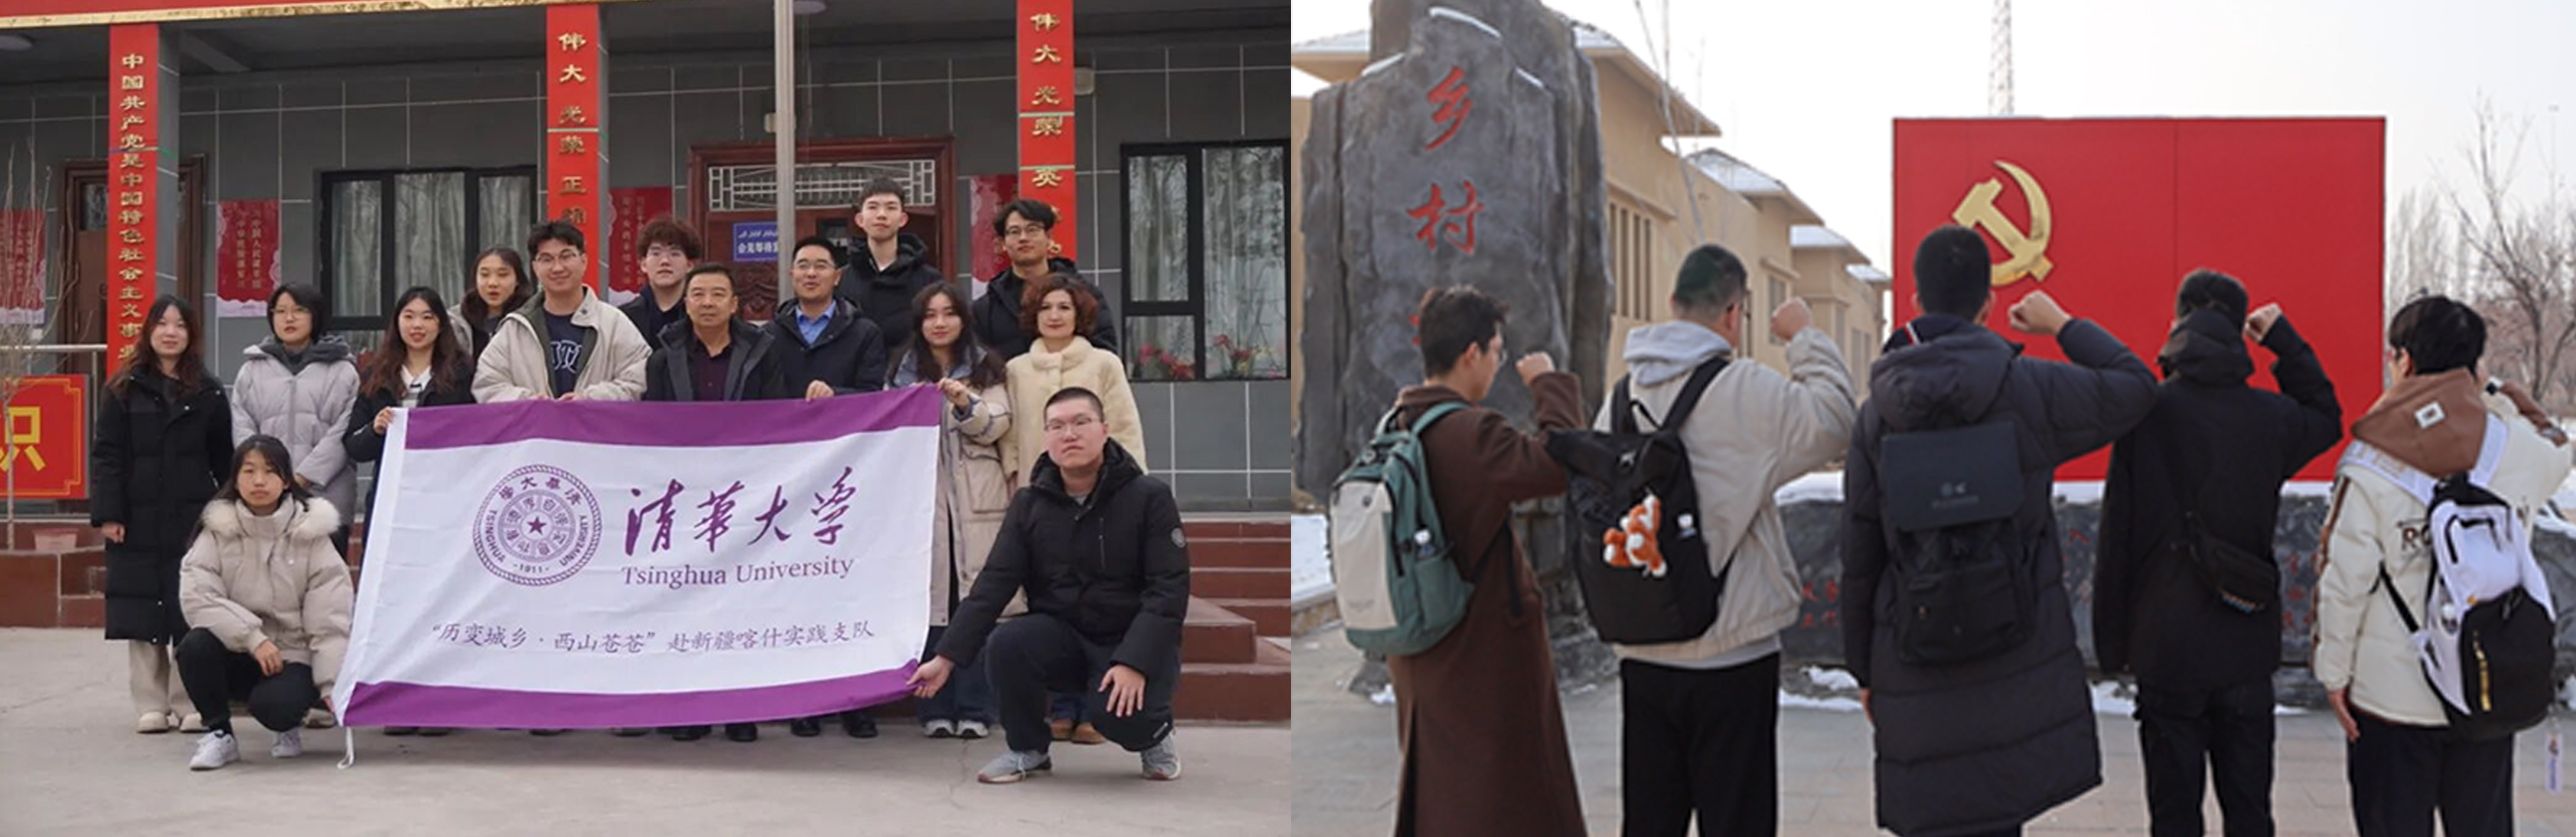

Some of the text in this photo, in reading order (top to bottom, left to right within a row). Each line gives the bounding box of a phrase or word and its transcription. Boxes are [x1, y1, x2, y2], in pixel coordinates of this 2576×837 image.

[485, 509, 506, 563] TSINGHUA
[559, 514, 589, 567] UNIVERSITY
[621, 556, 855, 589] Tsinghua University
